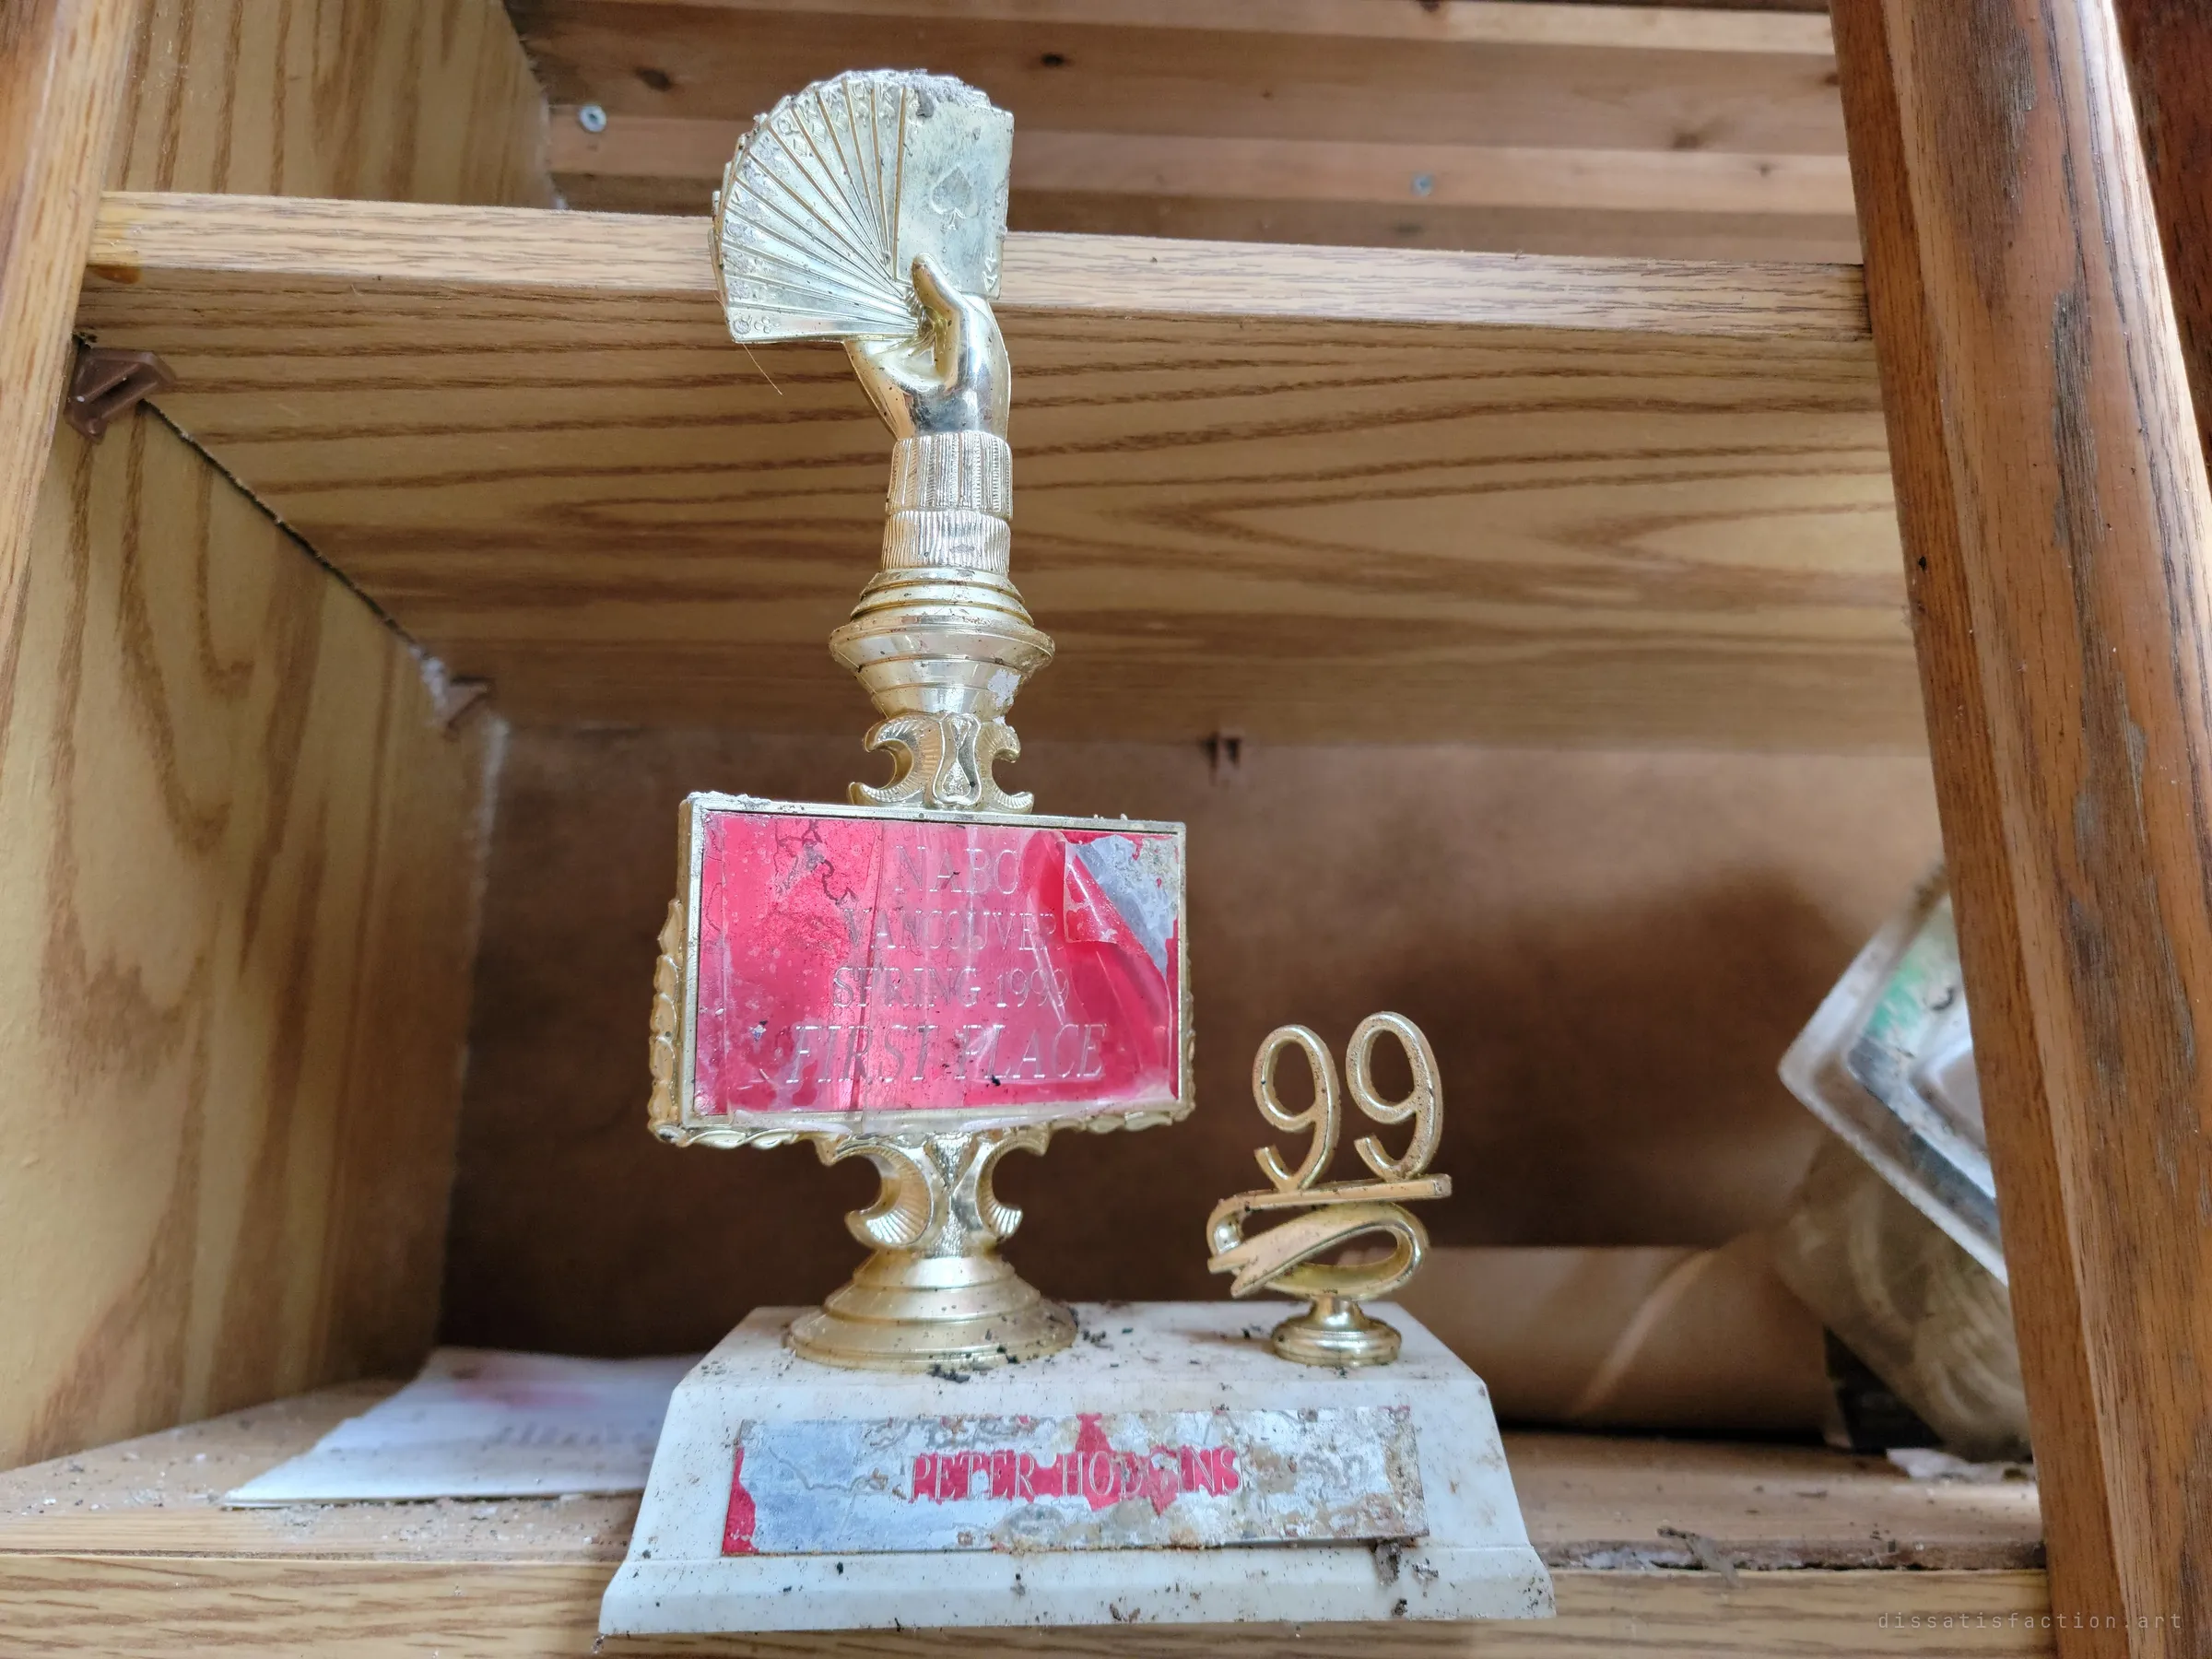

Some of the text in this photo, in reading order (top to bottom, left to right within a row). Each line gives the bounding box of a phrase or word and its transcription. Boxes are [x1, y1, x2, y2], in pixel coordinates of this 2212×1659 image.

[842, 909, 1065, 950] VANCOUVER
[832, 966, 1069, 1008] SPRING 1999
[786, 1022, 1108, 1084] FIRST PLACE
[1252, 1010, 1443, 1192] 99
[910, 1452, 1037, 1500] PETER
